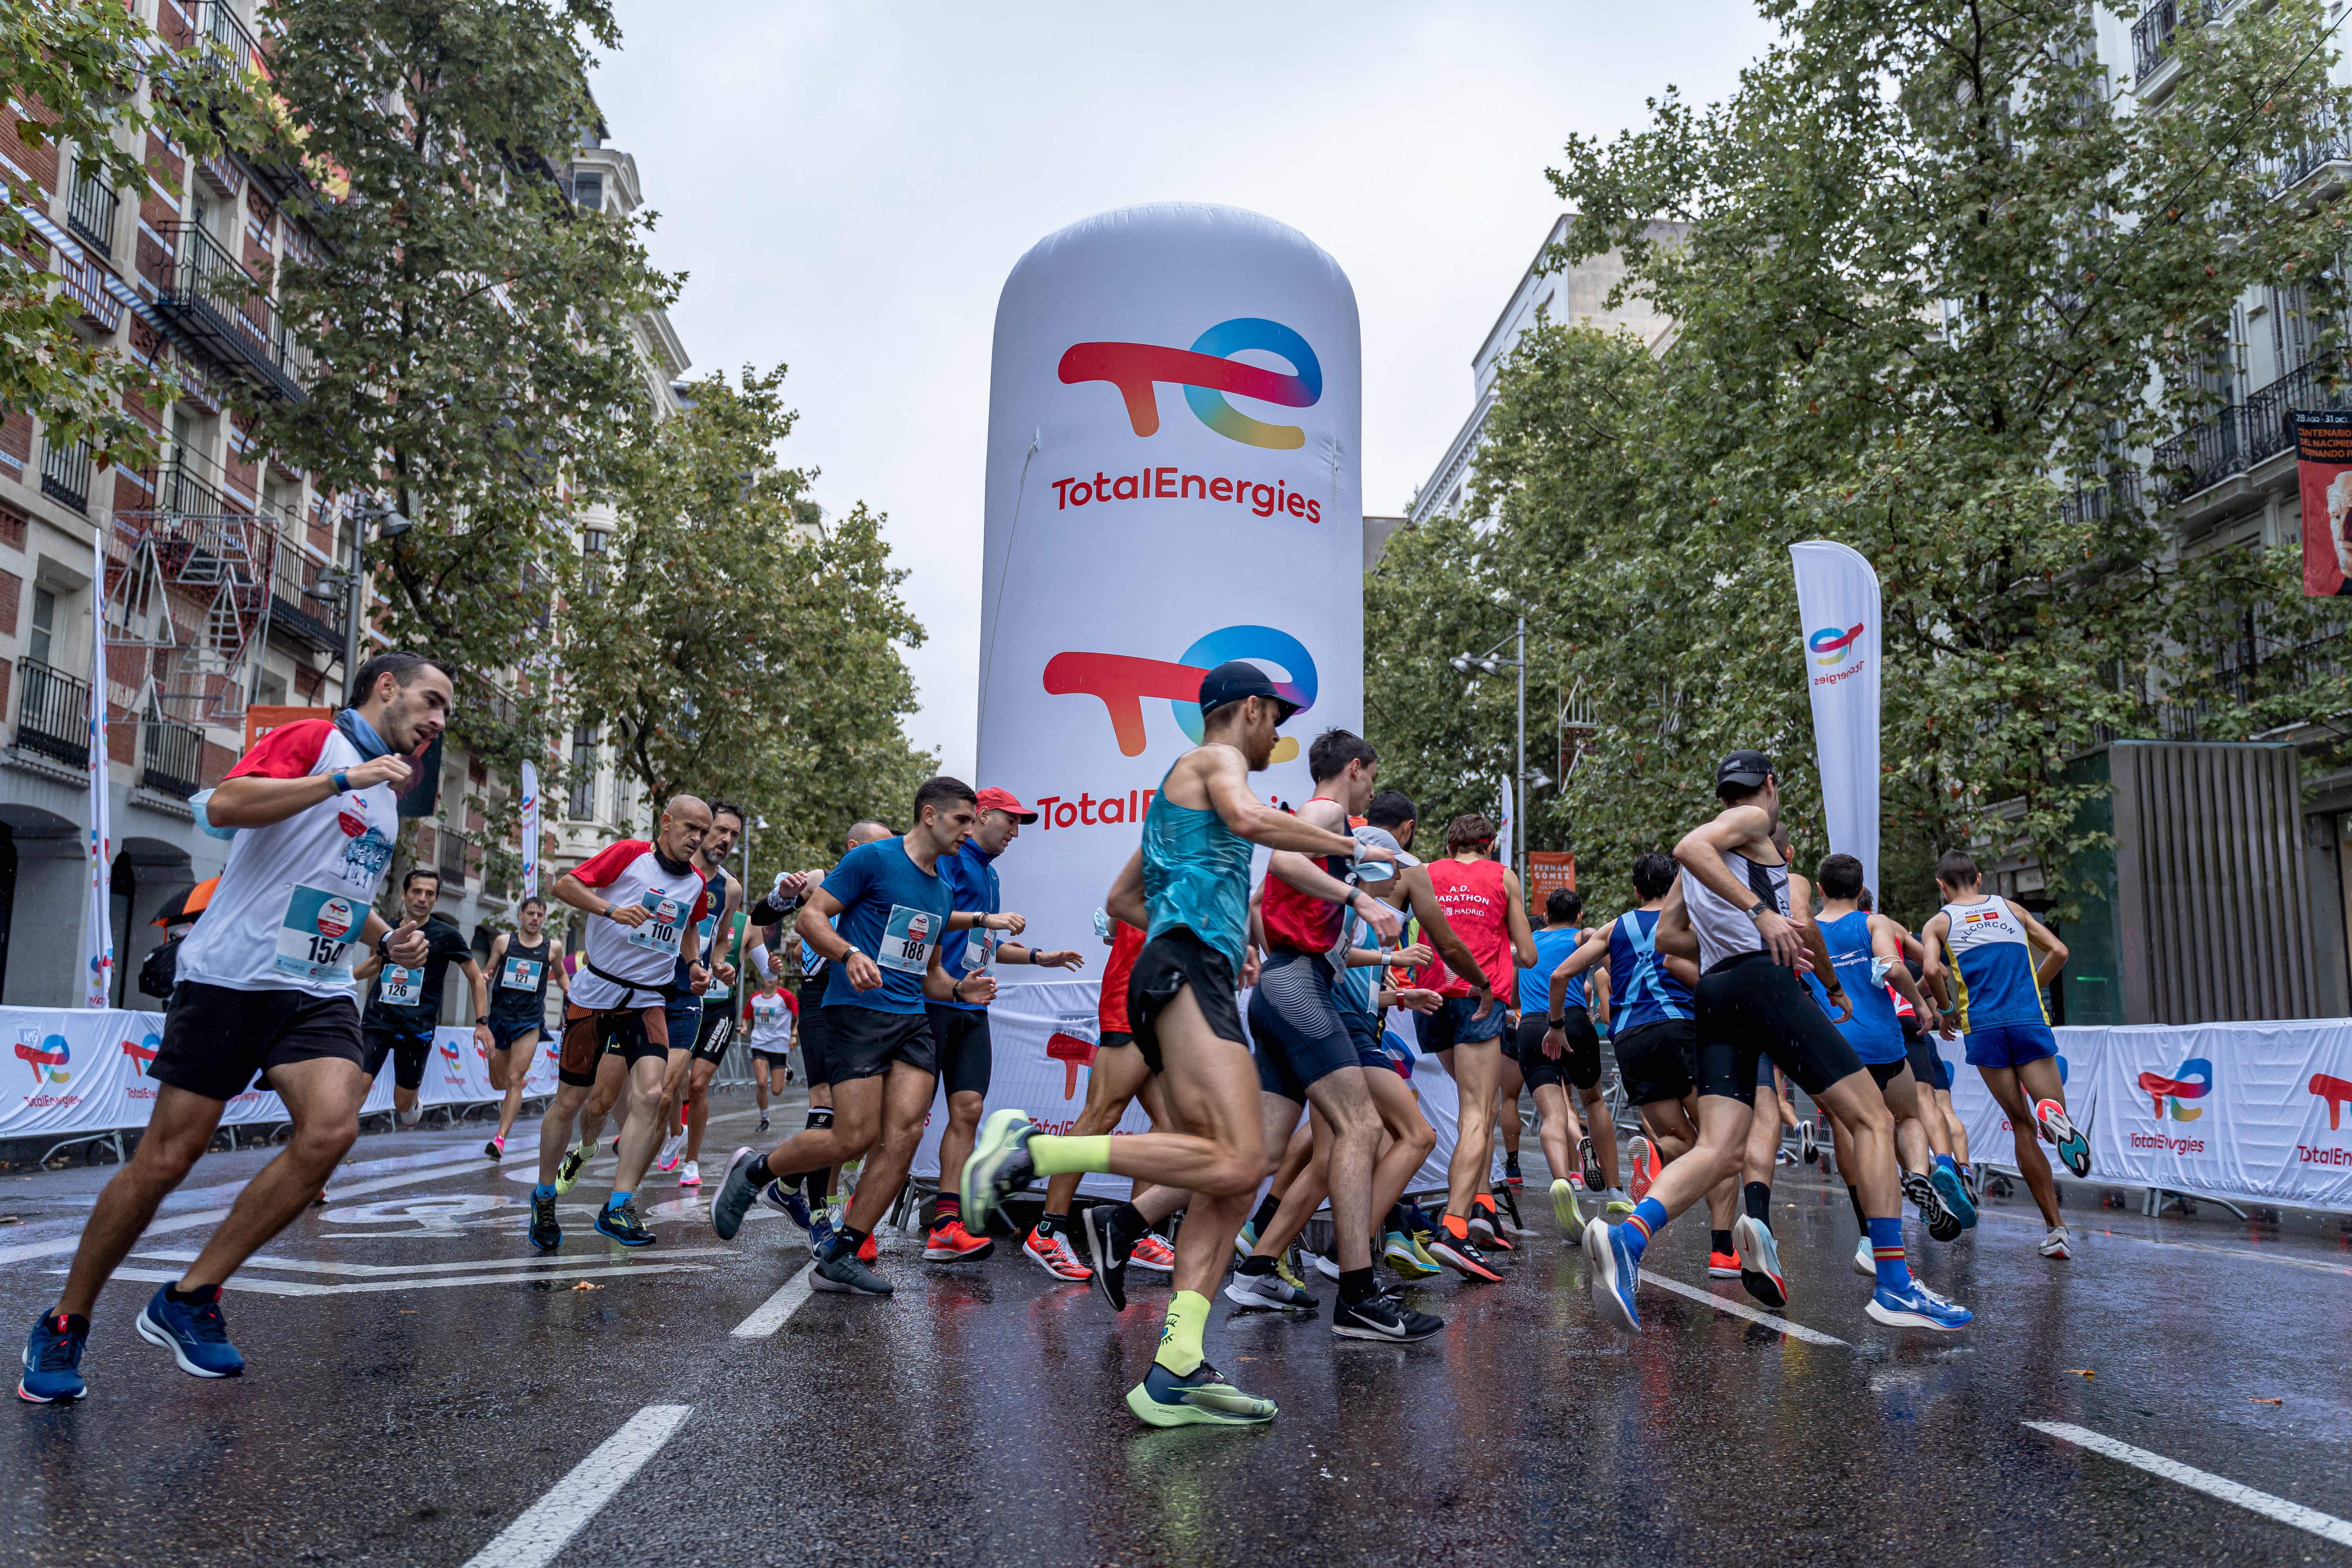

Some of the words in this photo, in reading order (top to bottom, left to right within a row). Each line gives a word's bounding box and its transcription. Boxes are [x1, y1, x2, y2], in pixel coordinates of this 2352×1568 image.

[2296, 414, 2305, 423] 28
[1052, 467, 1321, 524] TotalEnergies
[652, 923, 673, 942] 110
[1960, 922, 2015, 942] ALCORCÓN
[307, 936, 347, 967] 154
[902, 940, 925, 961] 188
[515, 974, 528, 984] 121
[388, 984, 407, 997] 126
